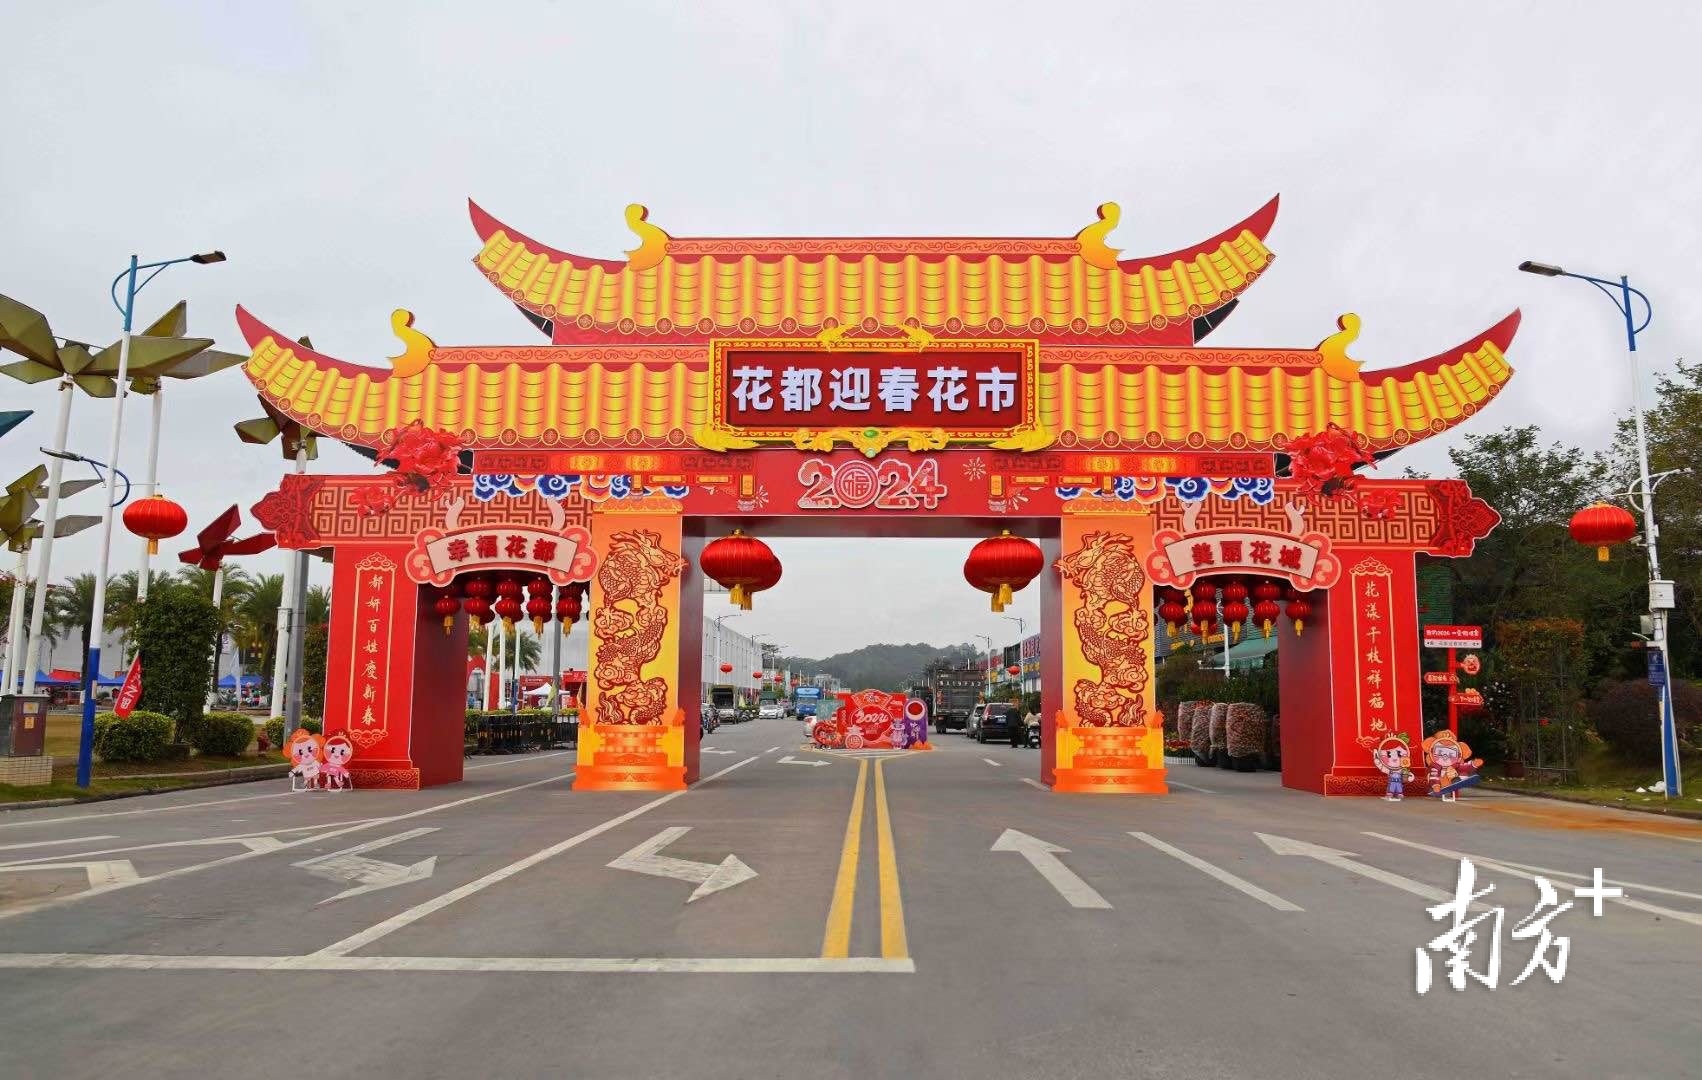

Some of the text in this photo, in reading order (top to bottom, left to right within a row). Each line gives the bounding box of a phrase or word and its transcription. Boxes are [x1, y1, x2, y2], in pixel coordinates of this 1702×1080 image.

[732, 366, 1018, 412] 花都迎春花市
[447, 535, 557, 562] 幸福花都
[1191, 540, 1303, 570] 美丽花城
